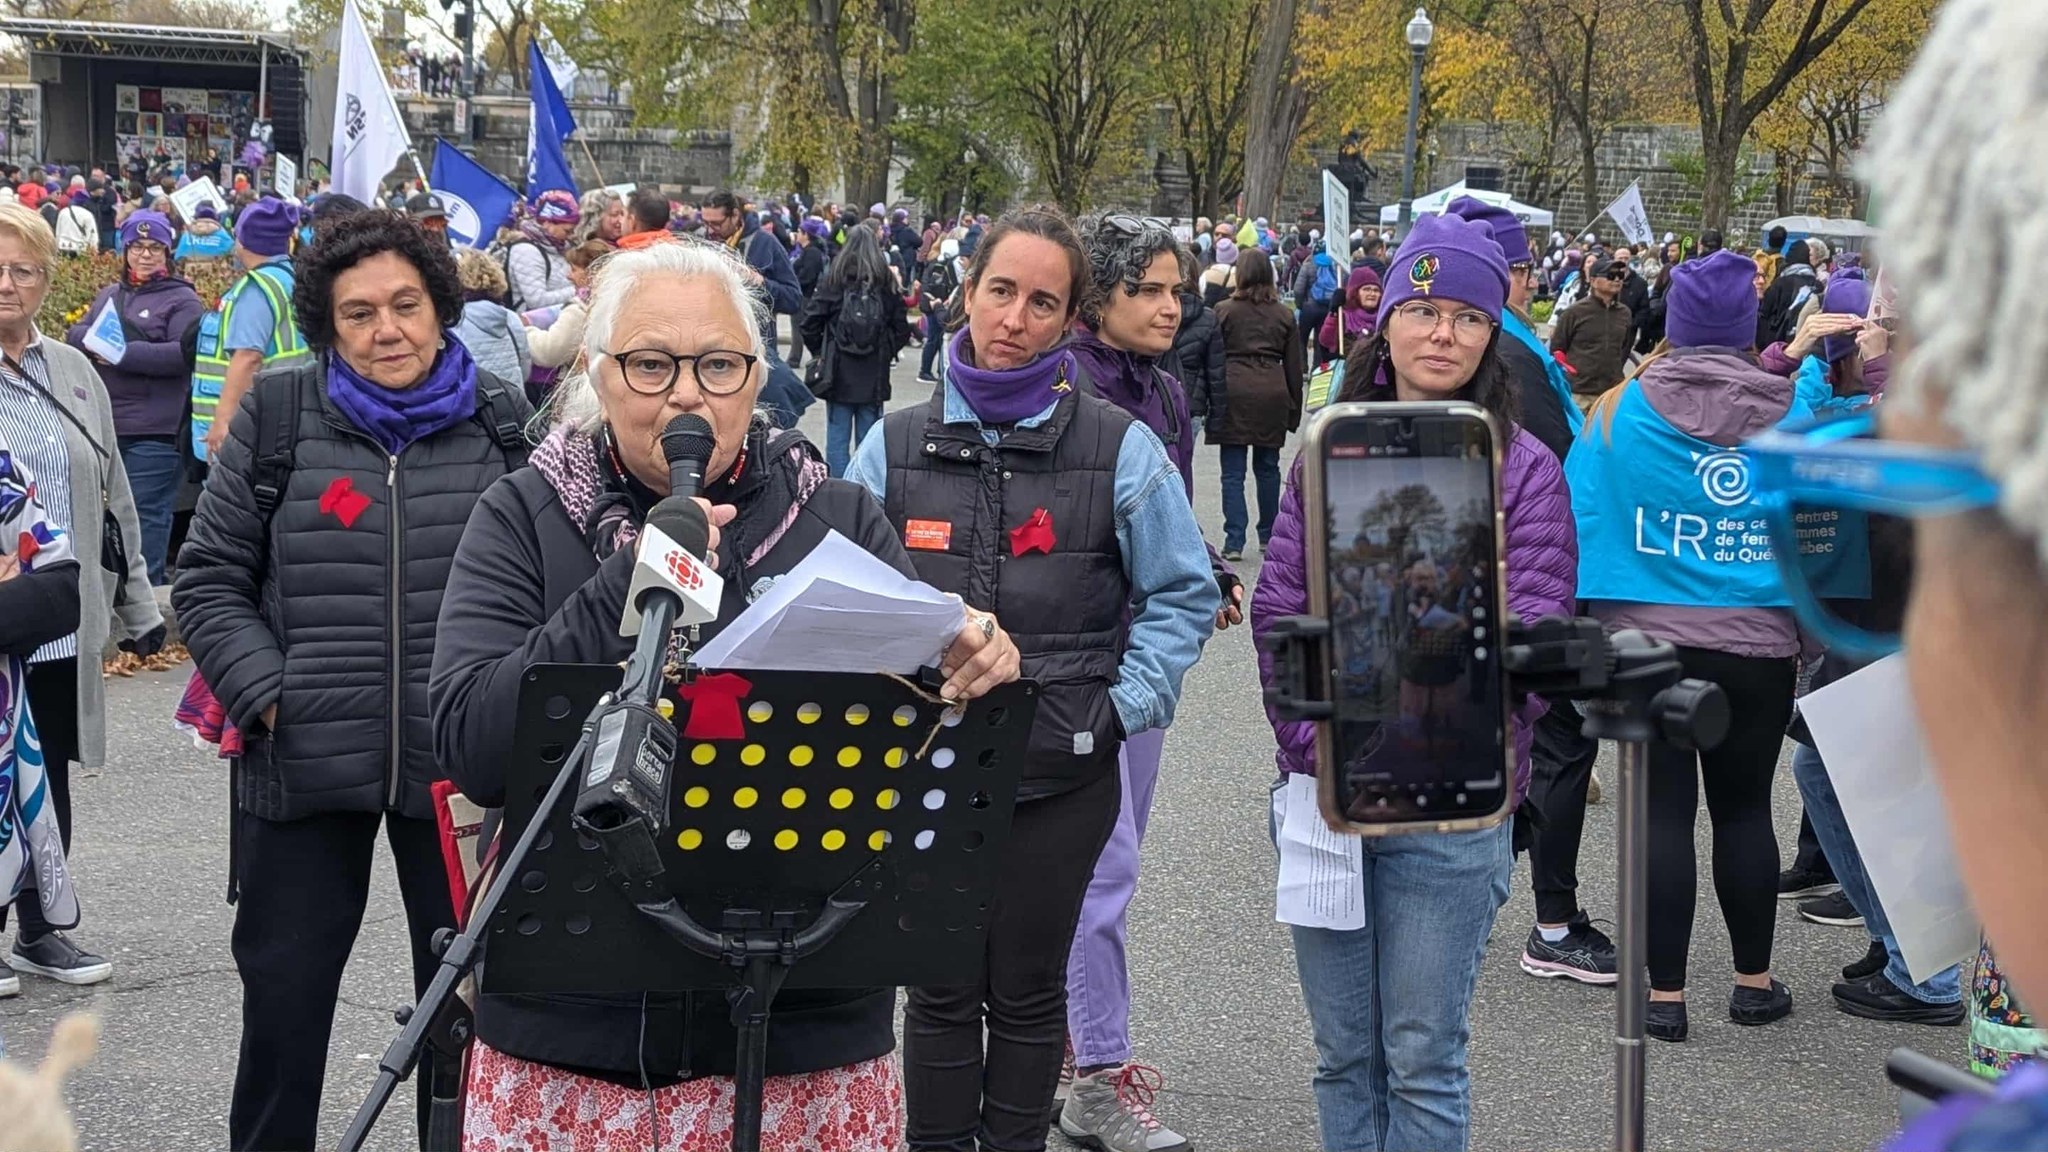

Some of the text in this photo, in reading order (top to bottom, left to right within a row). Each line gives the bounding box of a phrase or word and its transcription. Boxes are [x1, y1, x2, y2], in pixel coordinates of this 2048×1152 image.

[1716, 517, 1745, 531] des
[1636, 506, 1708, 561] L'R
[1714, 533, 1735, 546] de
[1713, 548, 1735, 562] du
